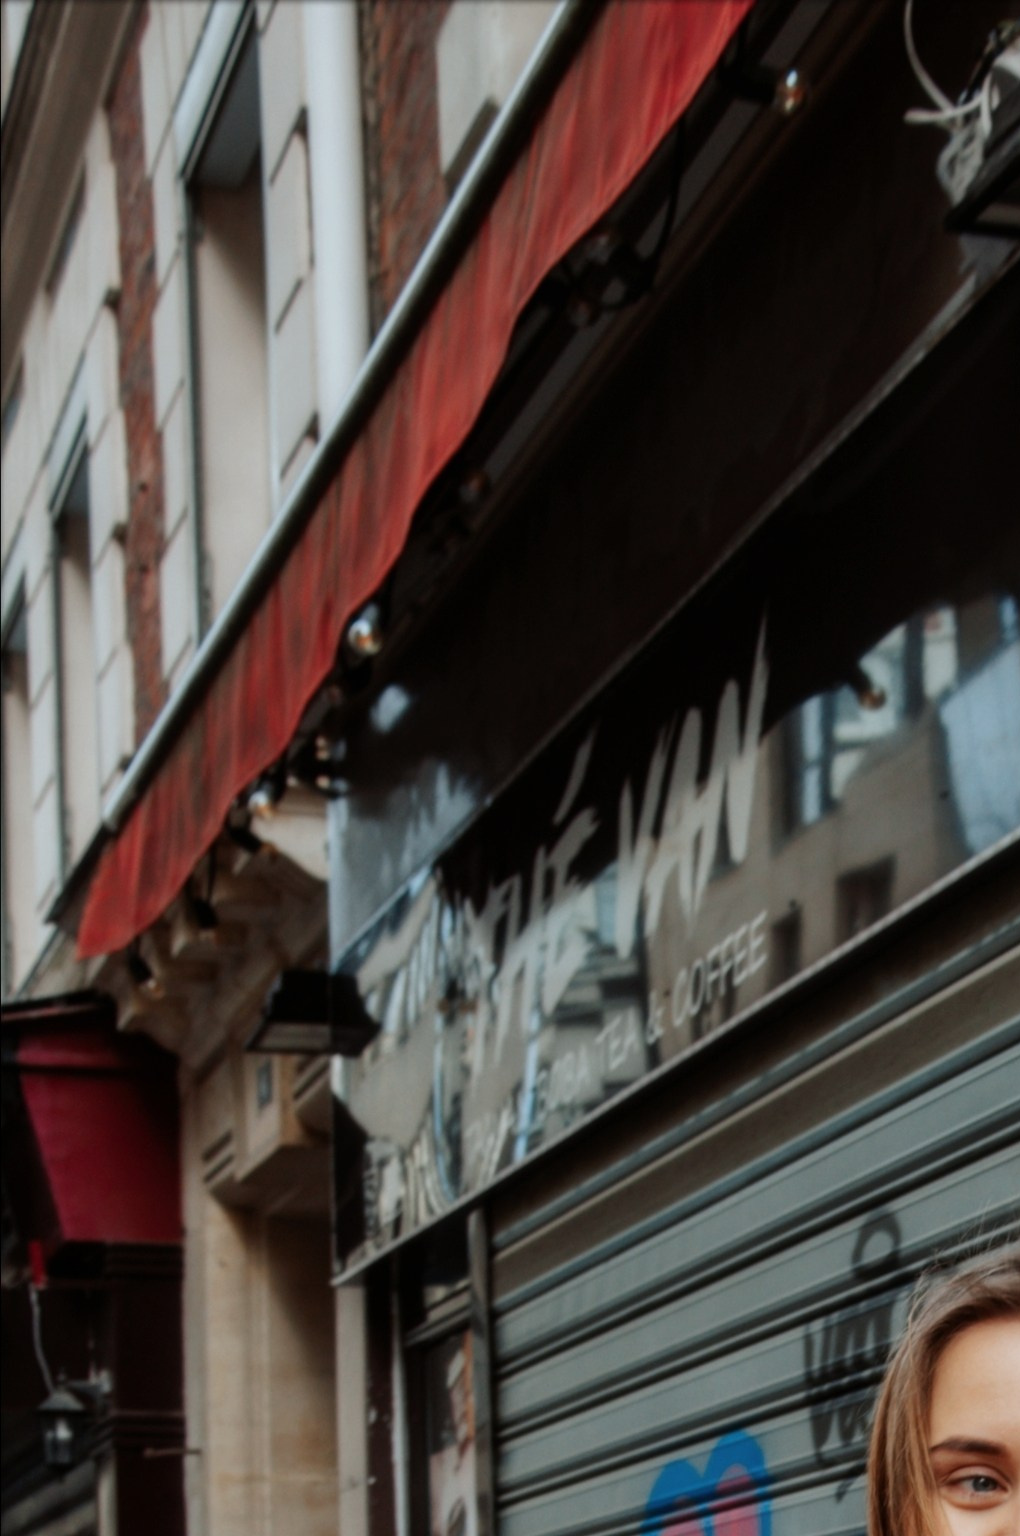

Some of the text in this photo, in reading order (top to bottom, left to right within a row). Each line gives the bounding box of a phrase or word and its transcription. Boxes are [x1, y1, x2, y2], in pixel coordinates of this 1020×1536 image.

[615, 605, 769, 960] VAN
[596, 1003, 641, 1072] TEA
[647, 990, 666, 1046] &
[672, 910, 768, 1028] COFFEE
